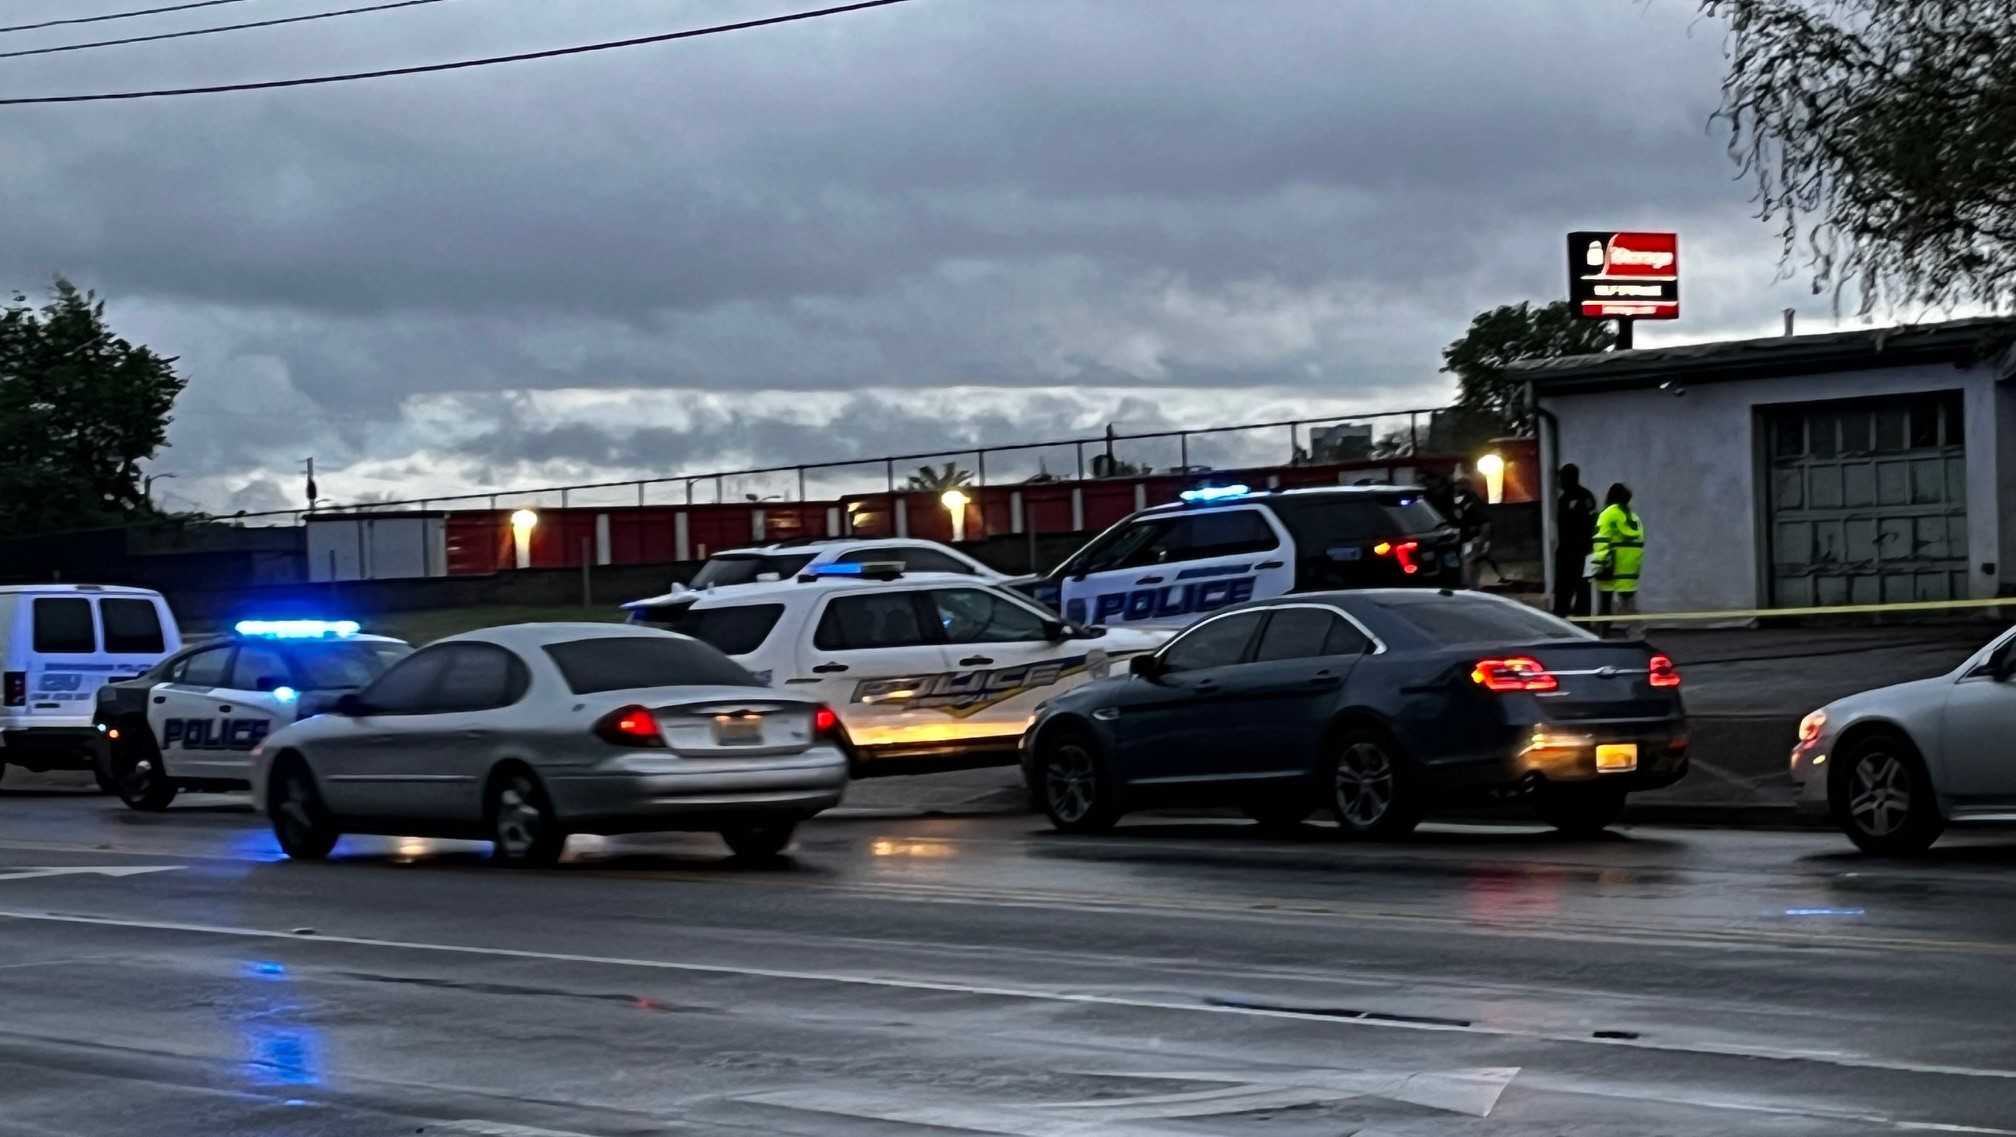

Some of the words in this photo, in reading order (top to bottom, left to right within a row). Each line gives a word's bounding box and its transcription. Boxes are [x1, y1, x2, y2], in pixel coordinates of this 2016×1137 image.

[1093, 575, 1257, 625] POLICE
[850, 663, 1064, 704] POLICE
[161, 718, 271, 751] POLICE
